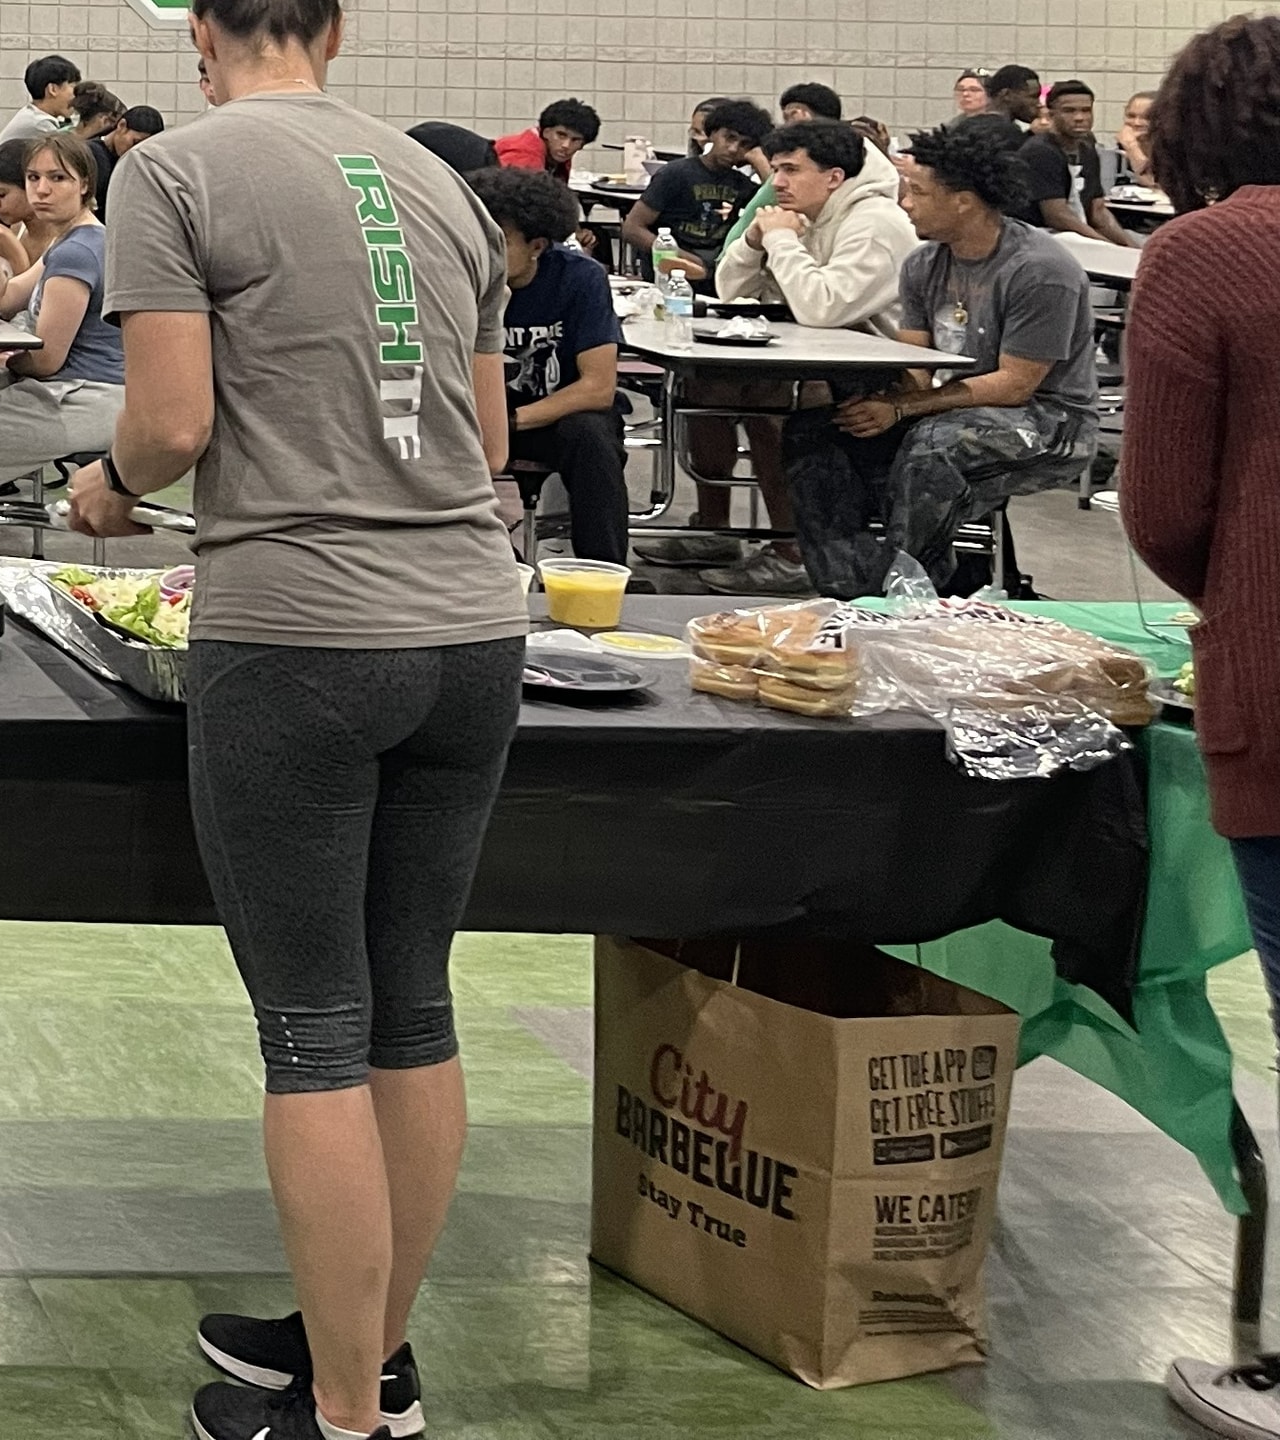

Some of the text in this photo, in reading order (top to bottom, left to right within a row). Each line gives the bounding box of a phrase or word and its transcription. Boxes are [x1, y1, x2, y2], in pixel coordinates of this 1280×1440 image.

[334, 154, 424, 363] IRISH
[650, 1043, 748, 1163] City
[869, 1048, 967, 1091] GET THE APP
[870, 1098, 901, 1135] GET
[906, 1090, 947, 1131] FREE
[616, 1083, 801, 1221] BARBEQUE
[638, 1172, 747, 1248] Stay True
[874, 1195, 913, 1224] WE
